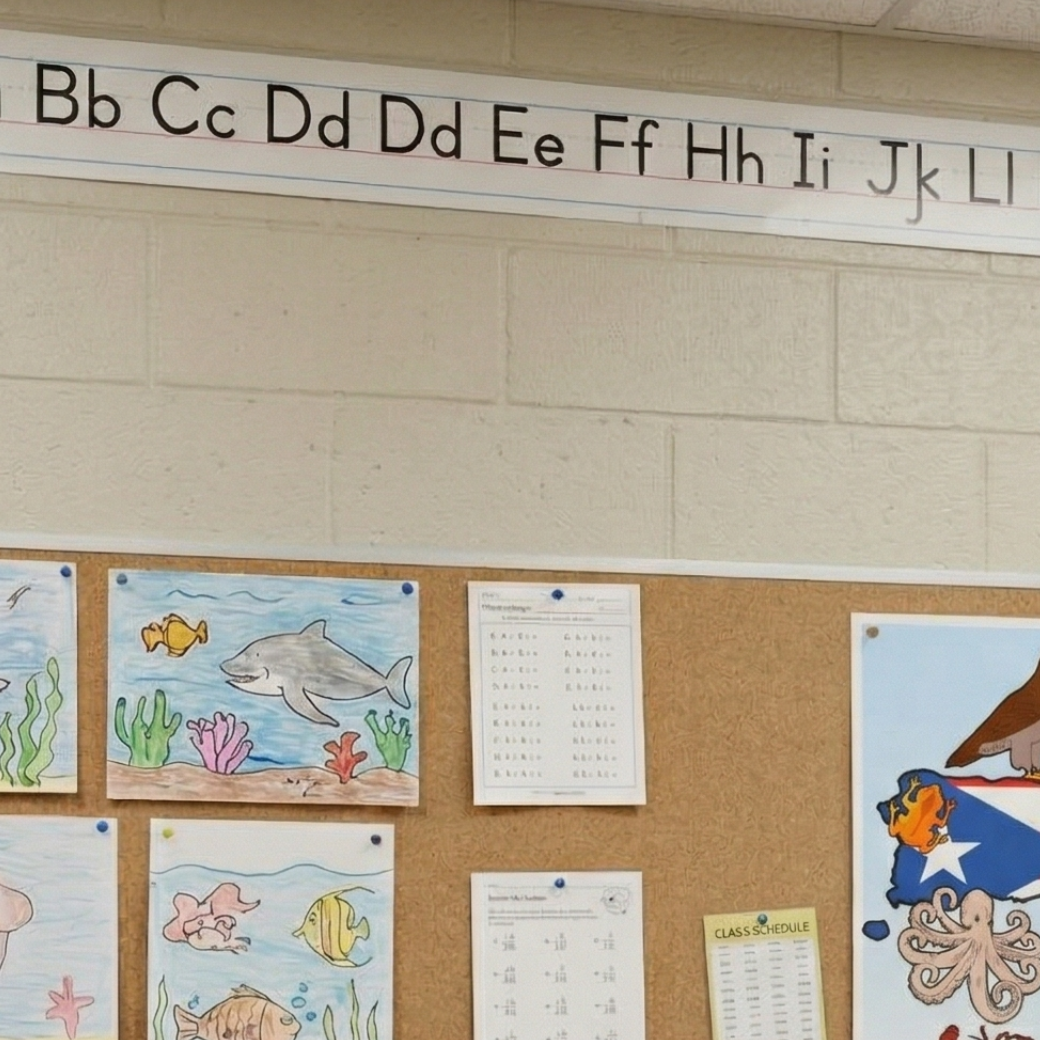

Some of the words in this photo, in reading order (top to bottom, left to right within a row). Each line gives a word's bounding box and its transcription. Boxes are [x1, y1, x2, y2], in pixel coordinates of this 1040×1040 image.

[36, 63, 121, 129] Bb
[152, 75, 236, 139] Cc
[266, 83, 350, 149] Dd
[380, 94, 462, 160] Dd
[492, 104, 565, 167] Ee
[594, 113, 660, 176] Ff
[686, 121, 764, 185] Hh
[793, 131, 830, 190] Ii
[715, 926, 751, 939] CLASS
[752, 922, 810, 937] SCHEDULE
